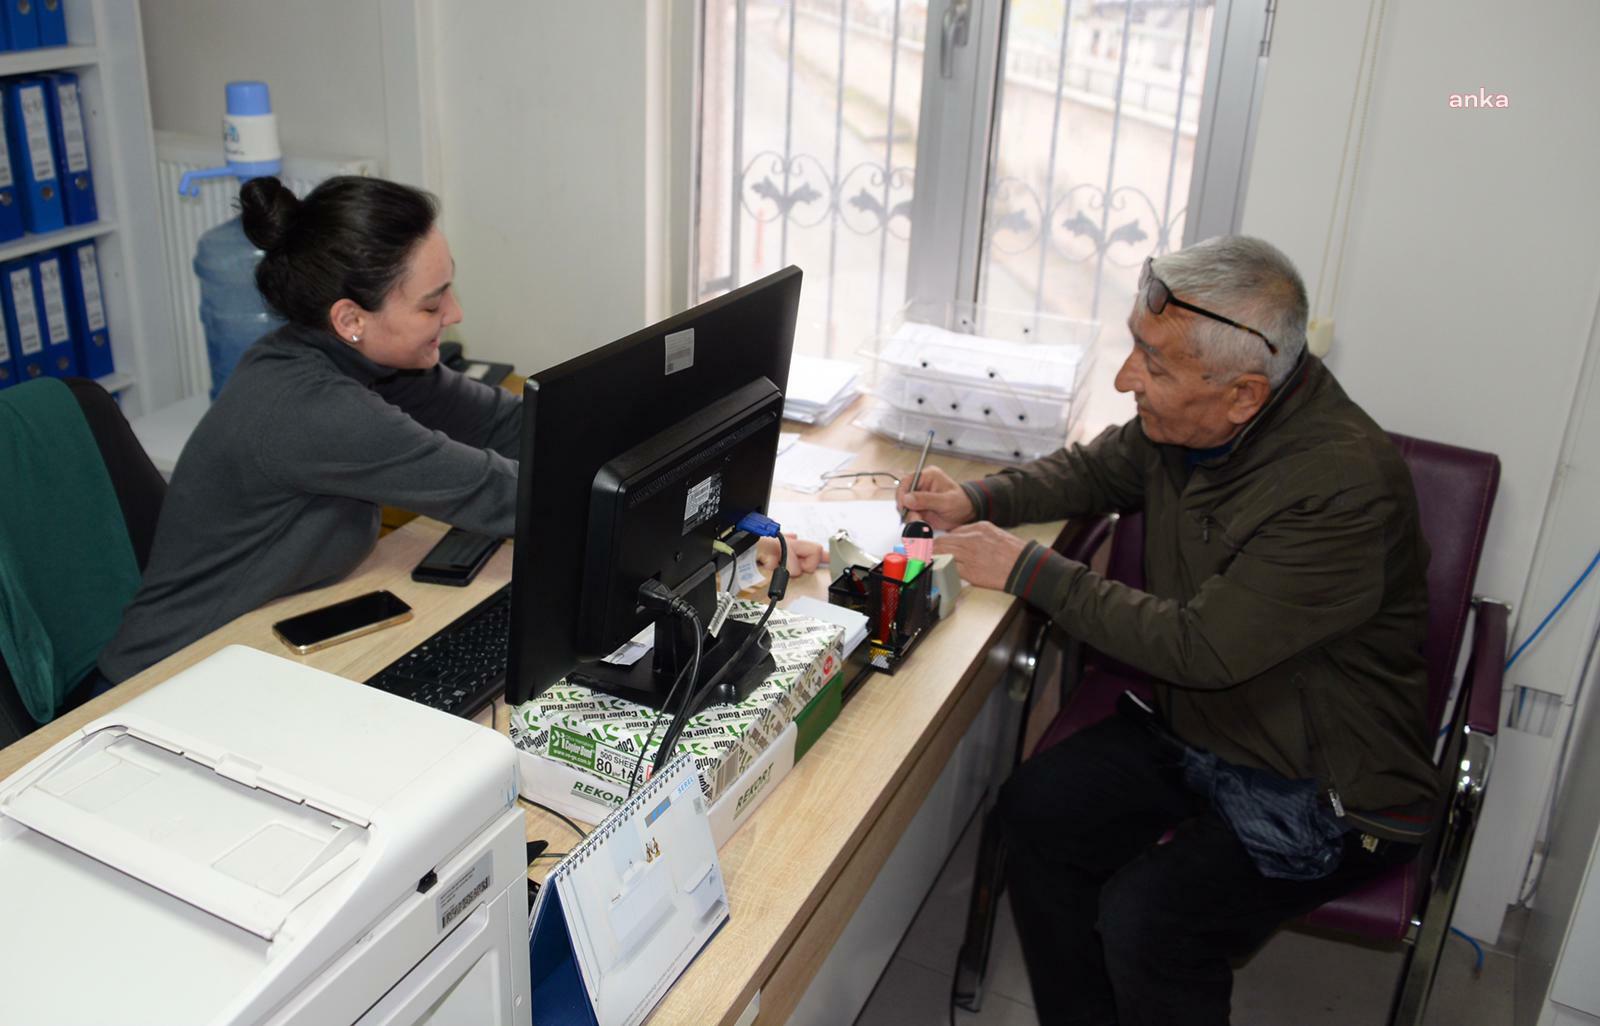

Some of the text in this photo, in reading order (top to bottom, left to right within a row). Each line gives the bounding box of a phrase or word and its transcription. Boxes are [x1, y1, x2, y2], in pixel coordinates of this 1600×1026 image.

[540, 701, 596, 717] Copier Bond
[583, 710, 638, 721] Copier Bond
[717, 711, 741, 721] Bond
[625, 720, 650, 729] Bond
[692, 726, 726, 736] Copier
[596, 758, 612, 775] 80
[572, 781, 624, 806] REKOR
